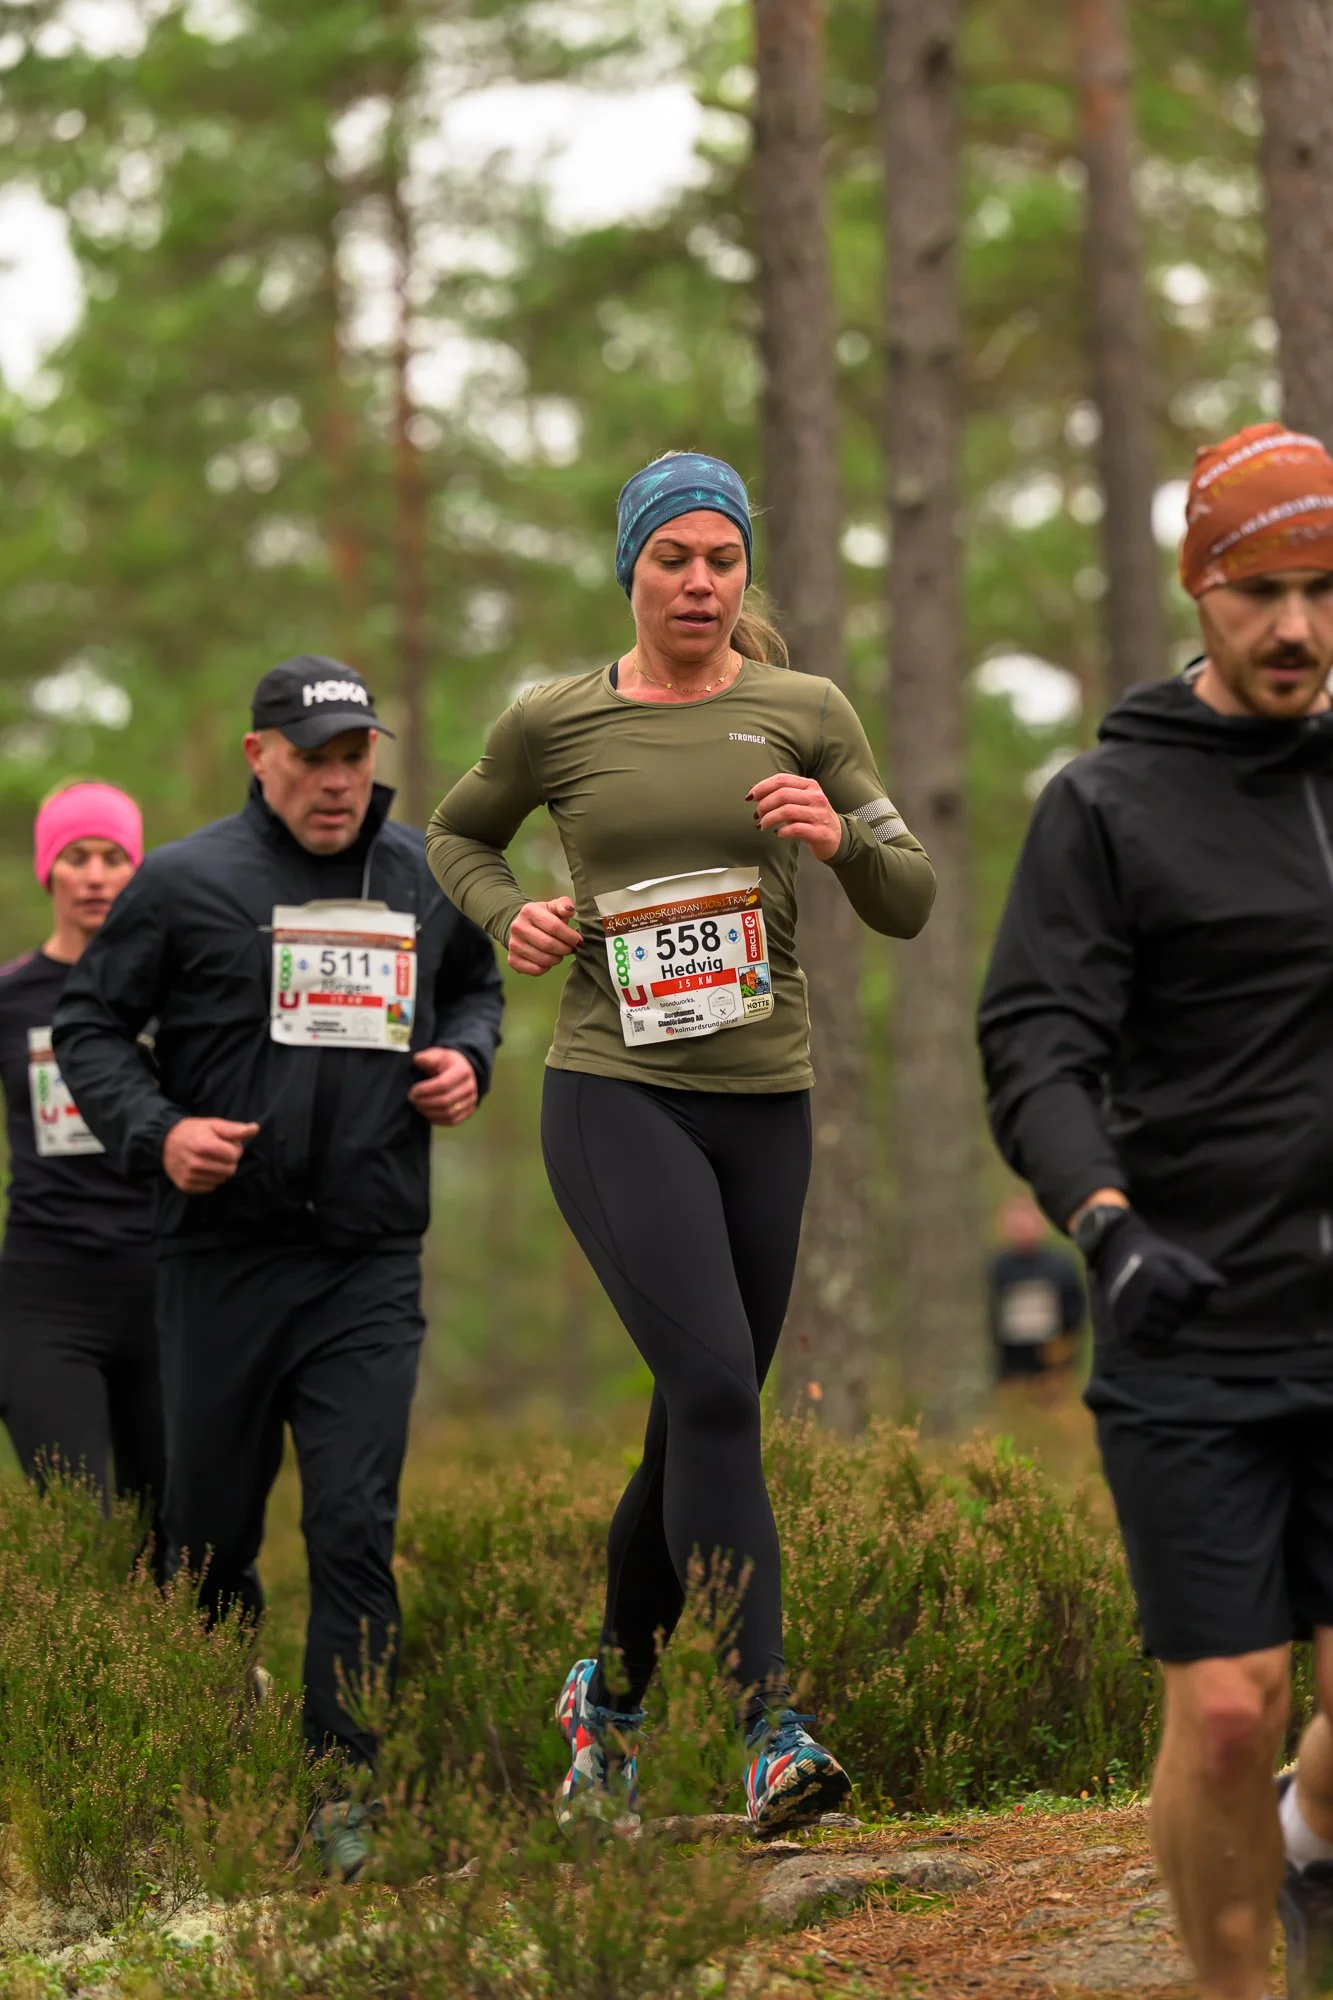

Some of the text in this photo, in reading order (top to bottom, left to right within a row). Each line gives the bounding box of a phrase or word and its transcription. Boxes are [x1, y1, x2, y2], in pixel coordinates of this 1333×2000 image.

[302, 680, 369, 708] HOKA
[729, 732, 766, 744] STRONGER
[656, 921, 720, 960] 558
[744, 915, 757, 958] CIRCLE K
[320, 951, 370, 977] 511
[613, 937, 630, 987] coop
[661, 956, 723, 979] Hedvig
[678, 975, 713, 989] 15 KM
[746, 1000, 770, 1009] NØTTE
